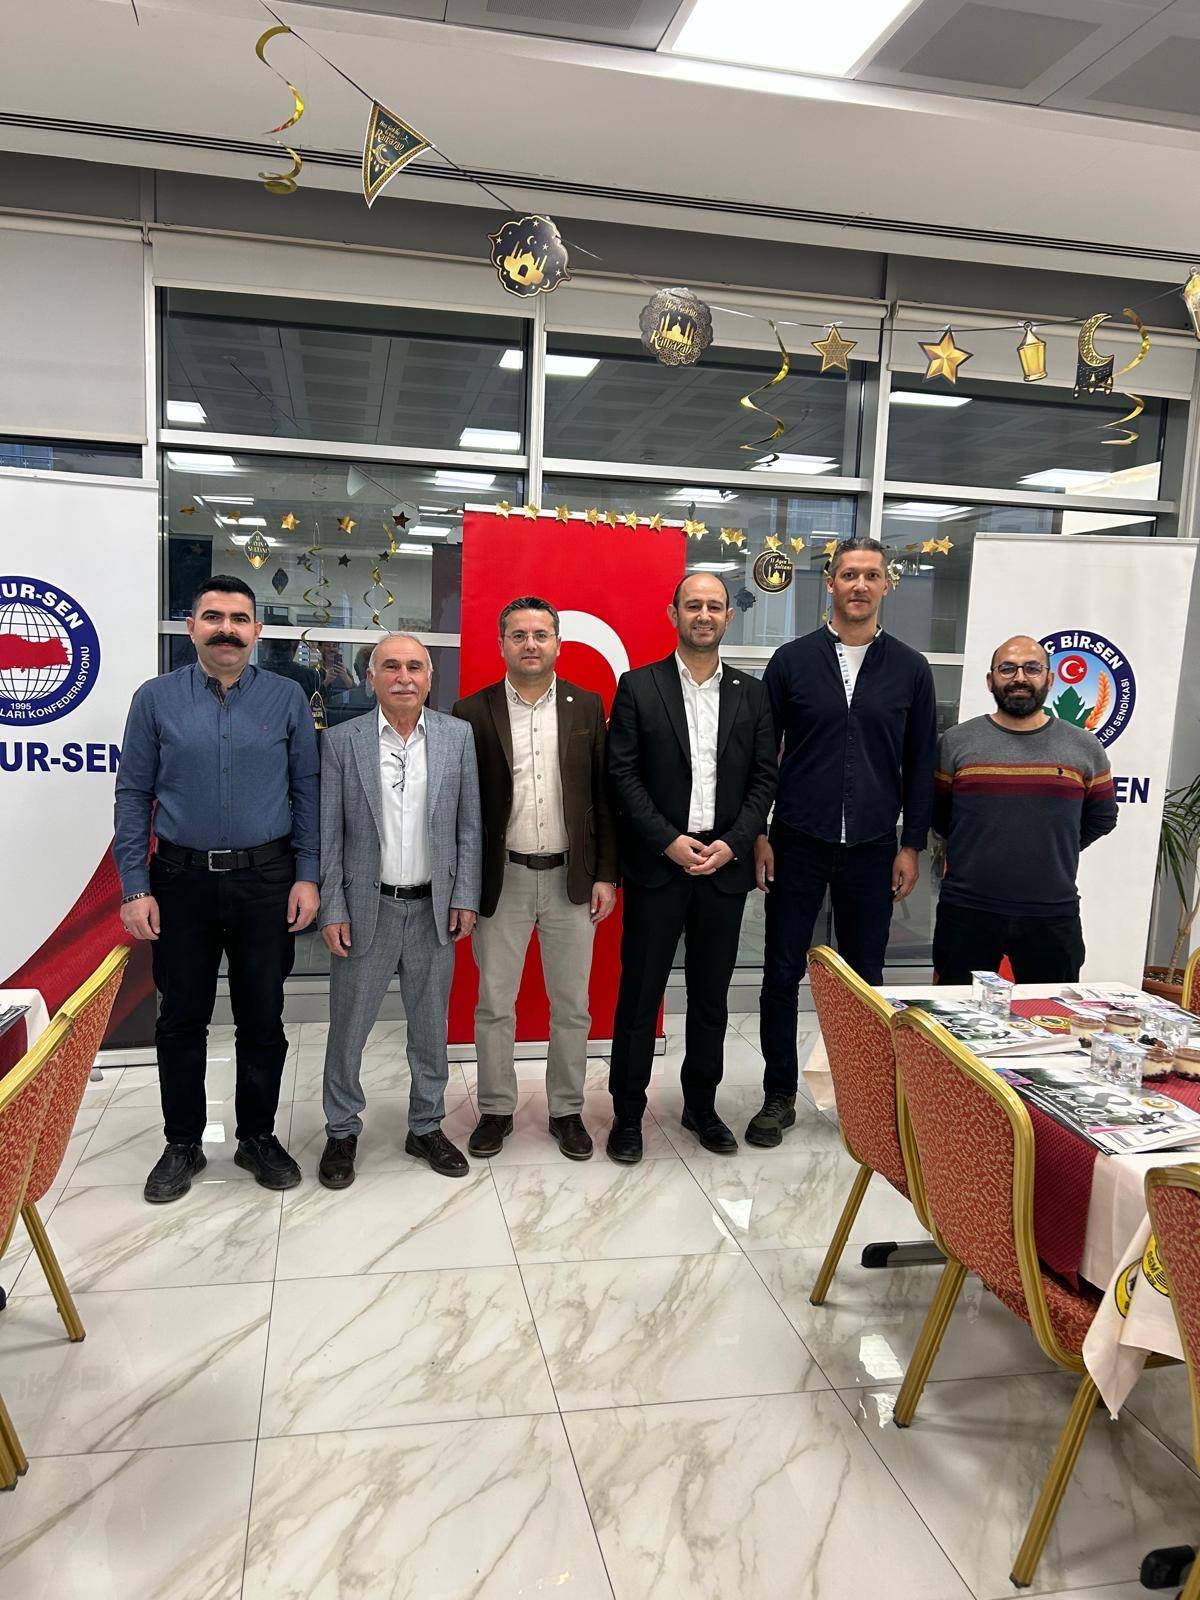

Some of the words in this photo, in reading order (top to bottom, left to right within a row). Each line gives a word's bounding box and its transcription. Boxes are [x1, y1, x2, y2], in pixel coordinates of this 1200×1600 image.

[650, 329, 692, 356] Ramazan
[0, 583, 84, 630] UR-SEN
[1060, 632, 1124, 670] BİR-SEN
[28, 646, 90, 719] KONFEDERASYONU
[1113, 677, 1131, 728] SENDİKASI
[10, 702, 32, 710] 1995
